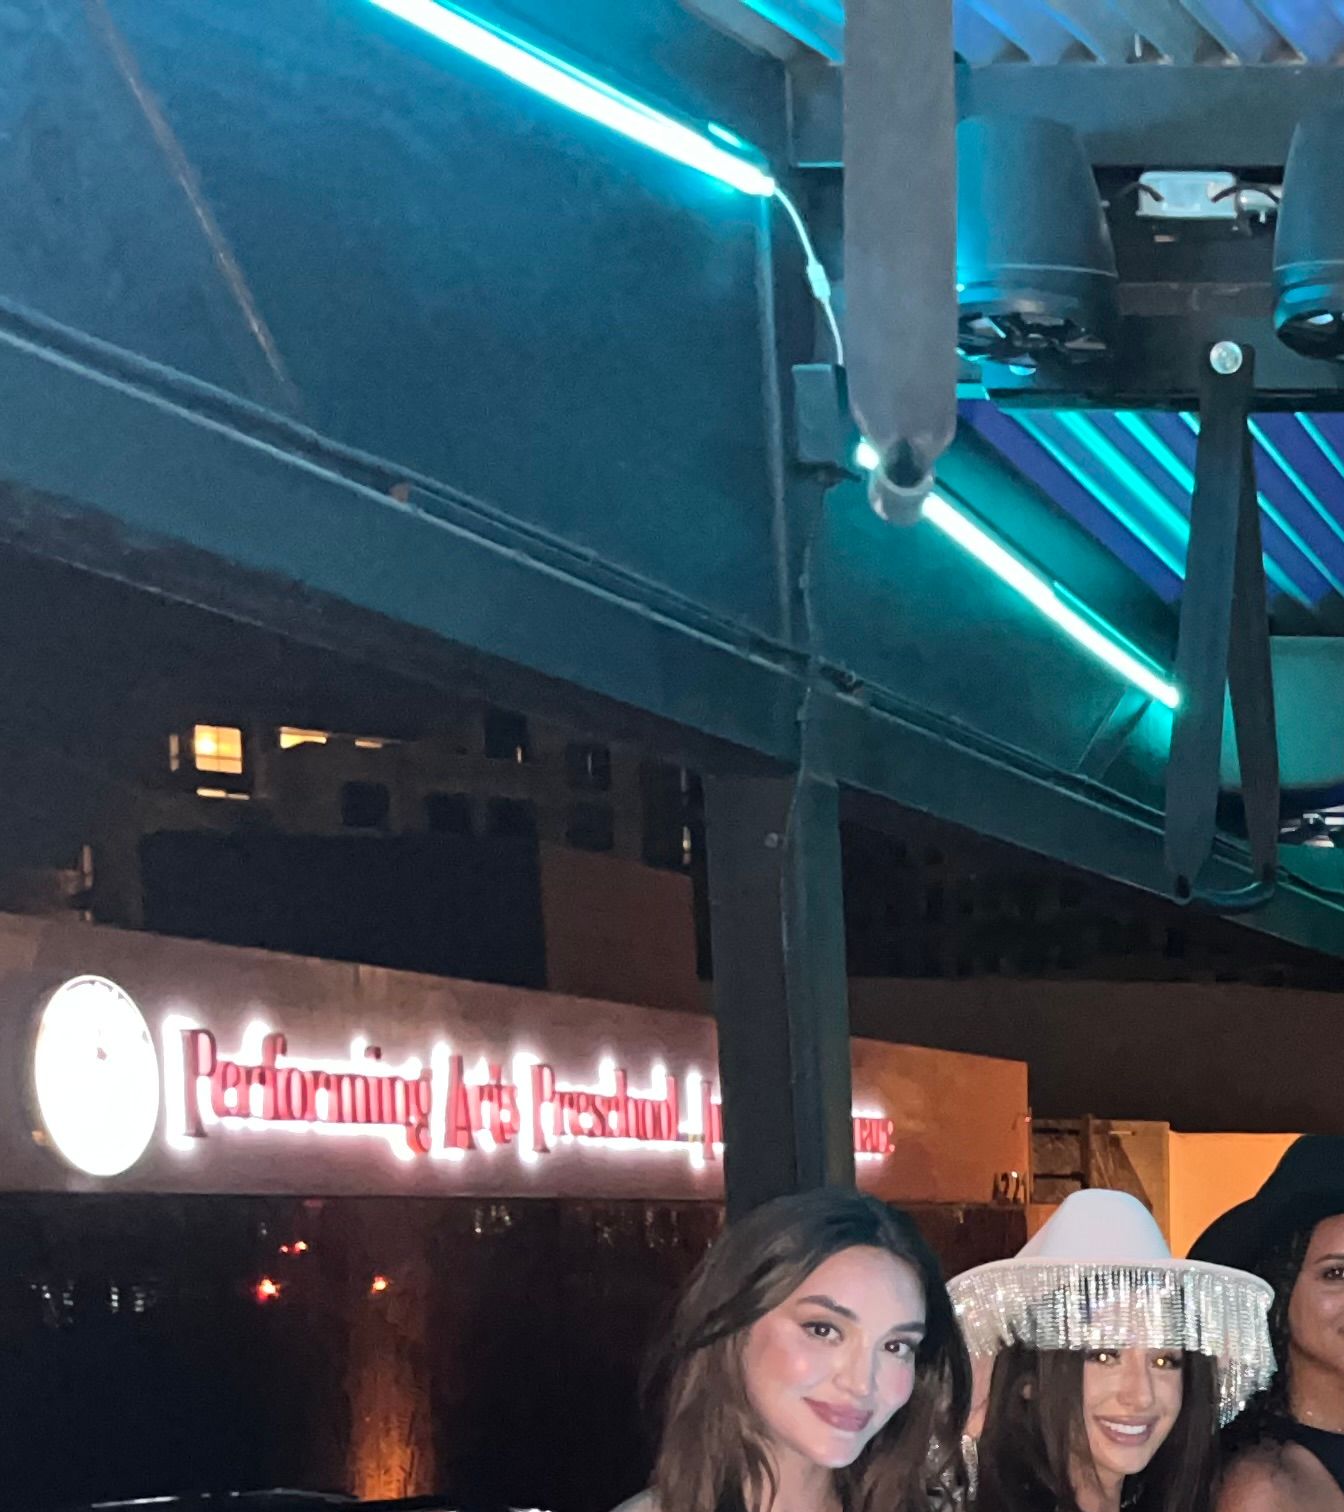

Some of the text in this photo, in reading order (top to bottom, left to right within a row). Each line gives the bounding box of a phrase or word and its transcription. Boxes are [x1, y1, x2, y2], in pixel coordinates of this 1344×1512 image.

[181, 1029, 432, 1153] Performing
[444, 1055, 518, 1151] Arts
[530, 1064, 678, 1153] Preschool
